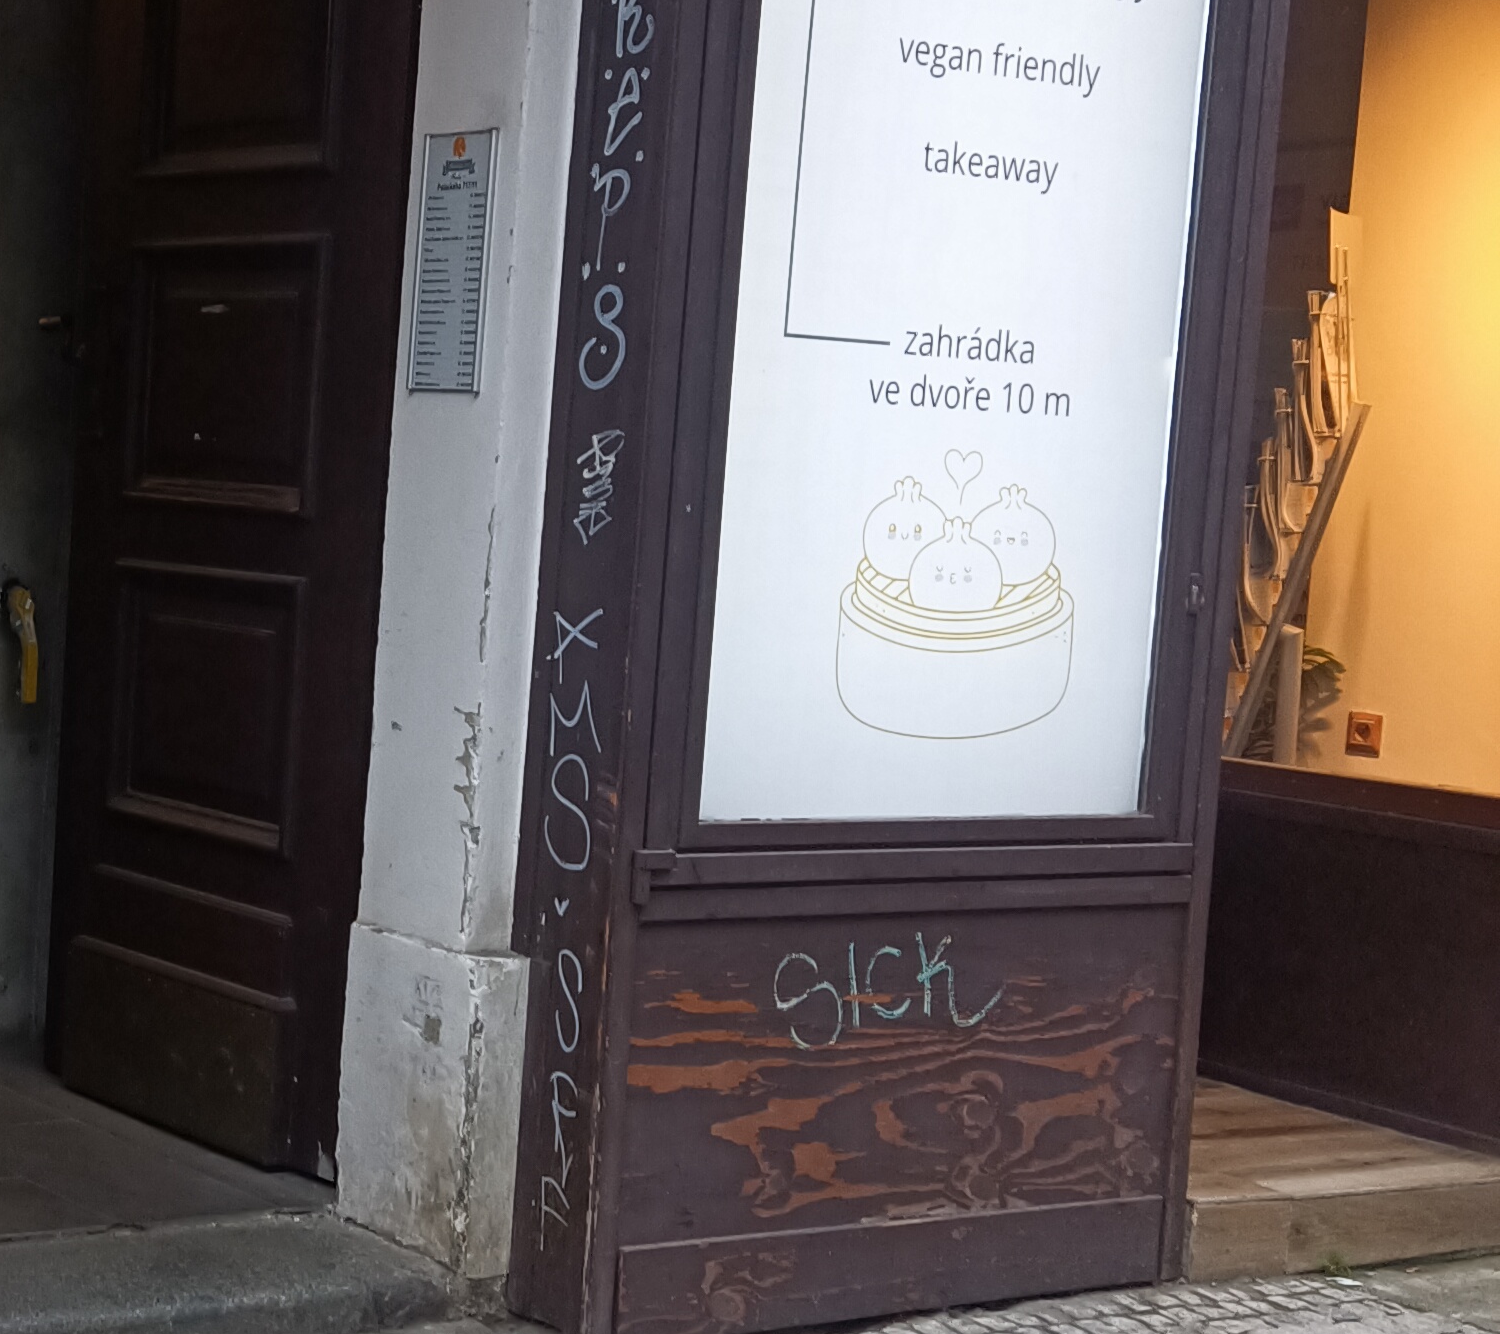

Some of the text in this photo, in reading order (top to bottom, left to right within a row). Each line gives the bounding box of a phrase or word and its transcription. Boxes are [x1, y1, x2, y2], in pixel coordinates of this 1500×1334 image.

[899, 37, 1101, 98] vegan friendly
[924, 141, 1059, 195] takeaway
[904, 324, 1036, 365] zahrádka
[869, 374, 1071, 418] ve dvoře 10 m
[774, 932, 1006, 1051] SICK
